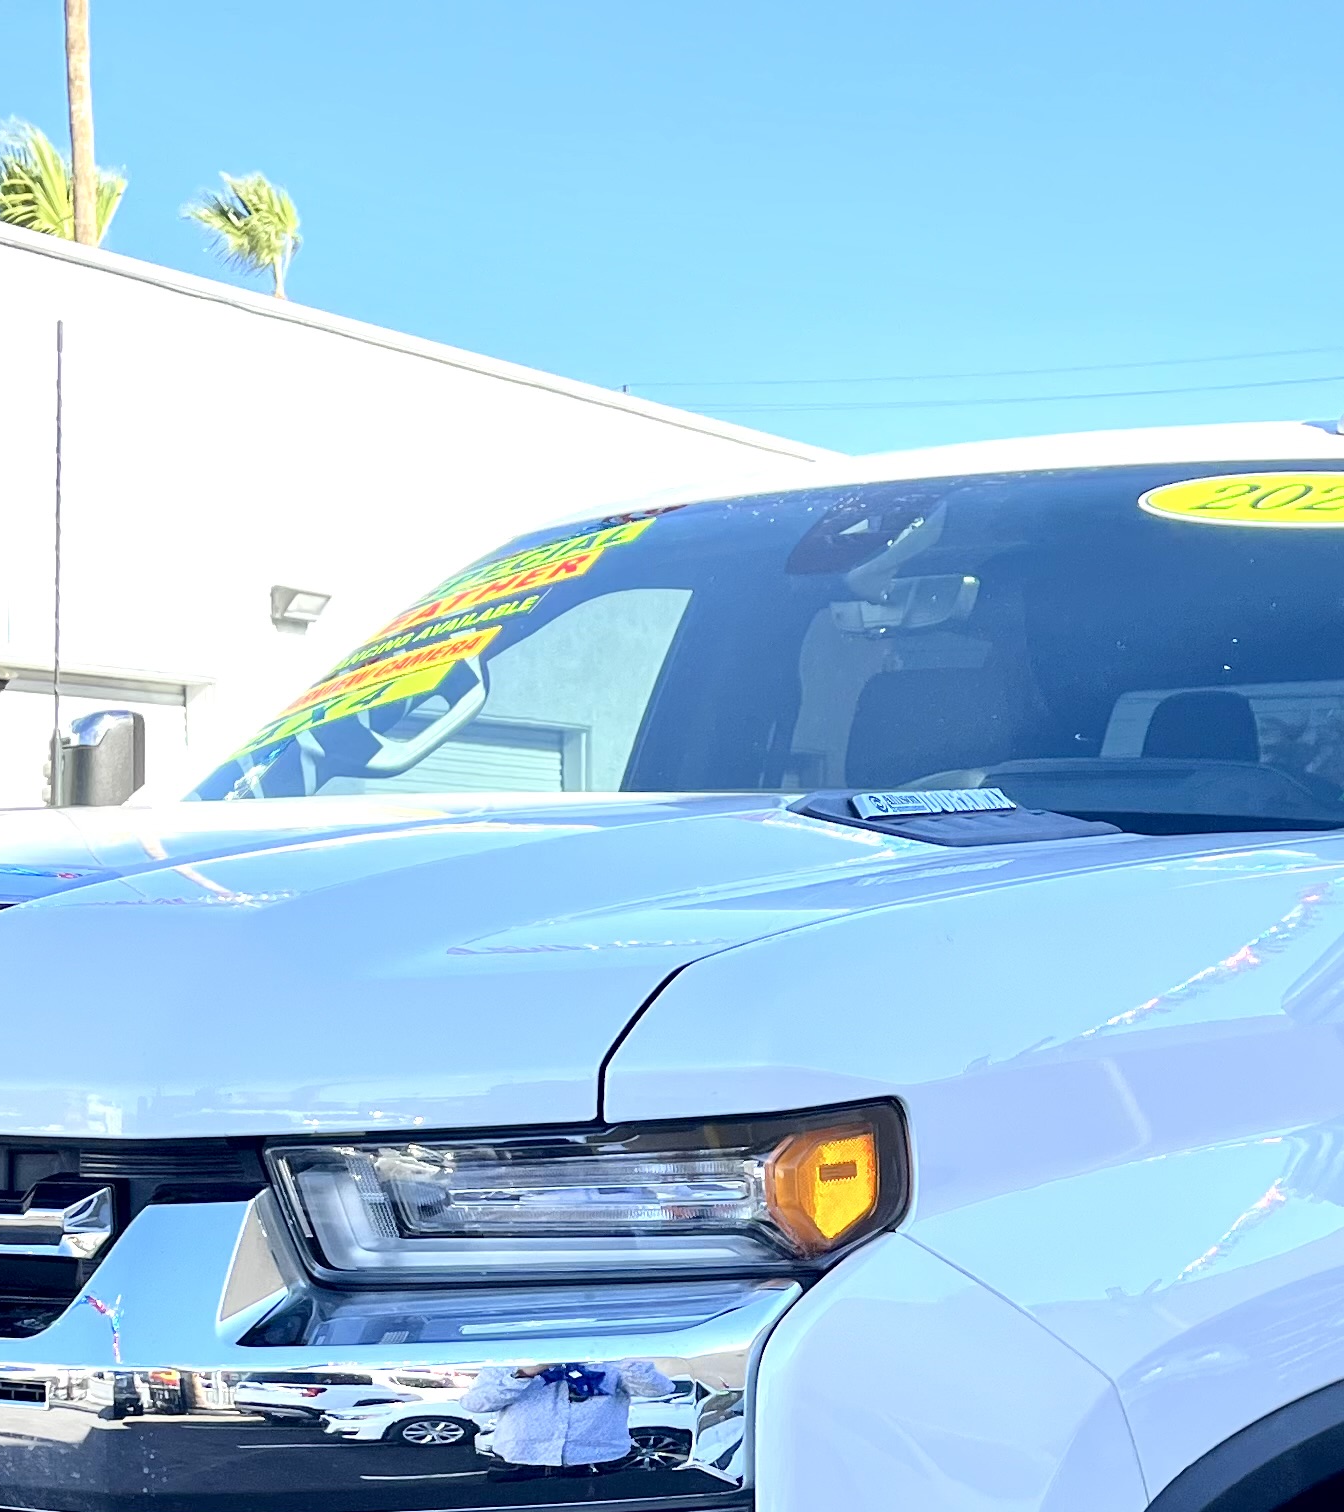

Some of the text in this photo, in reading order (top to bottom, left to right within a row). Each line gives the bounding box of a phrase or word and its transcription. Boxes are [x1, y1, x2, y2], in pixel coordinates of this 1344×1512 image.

[381, 553, 591, 634] EATHER
[331, 595, 540, 671] ANCING AVAILABLE
[372, 635, 485, 679] CAMERA
